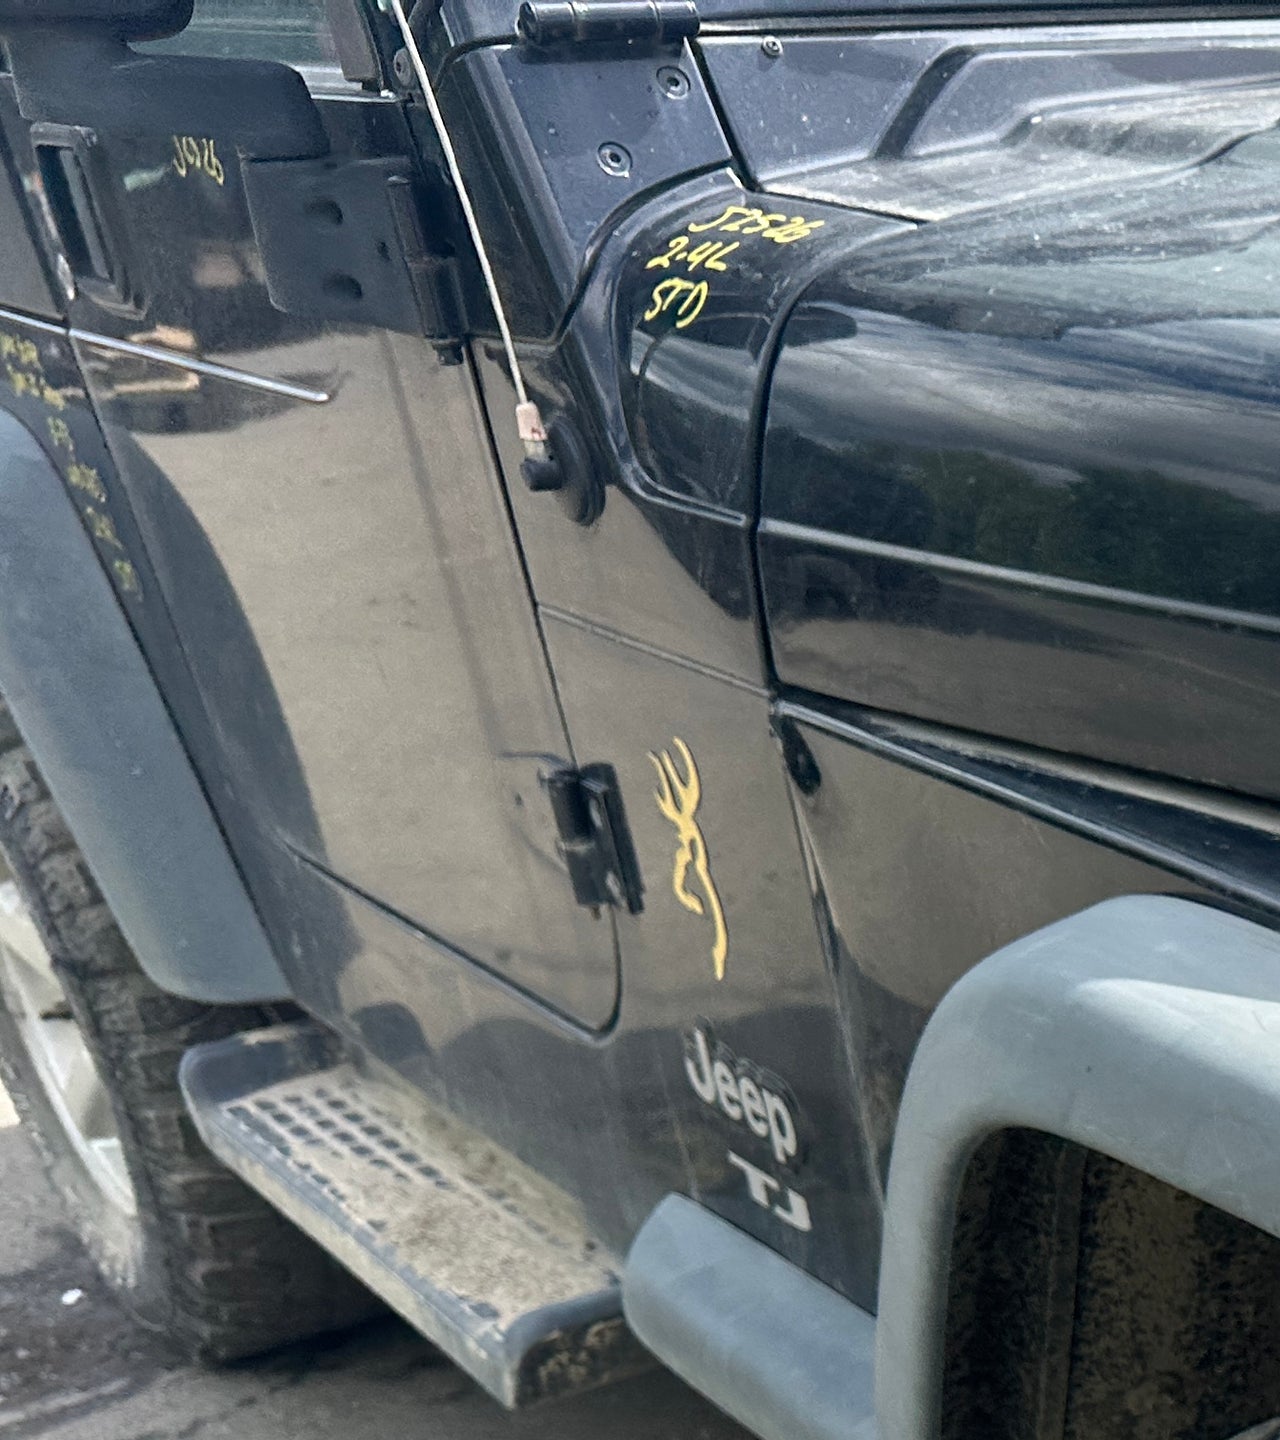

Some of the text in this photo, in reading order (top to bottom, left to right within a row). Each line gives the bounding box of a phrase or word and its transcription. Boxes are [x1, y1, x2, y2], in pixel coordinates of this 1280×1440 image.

[644, 277, 709, 329] STD
[683, 1026, 796, 1164] Jeep
[728, 1150, 813, 1232] TJ
